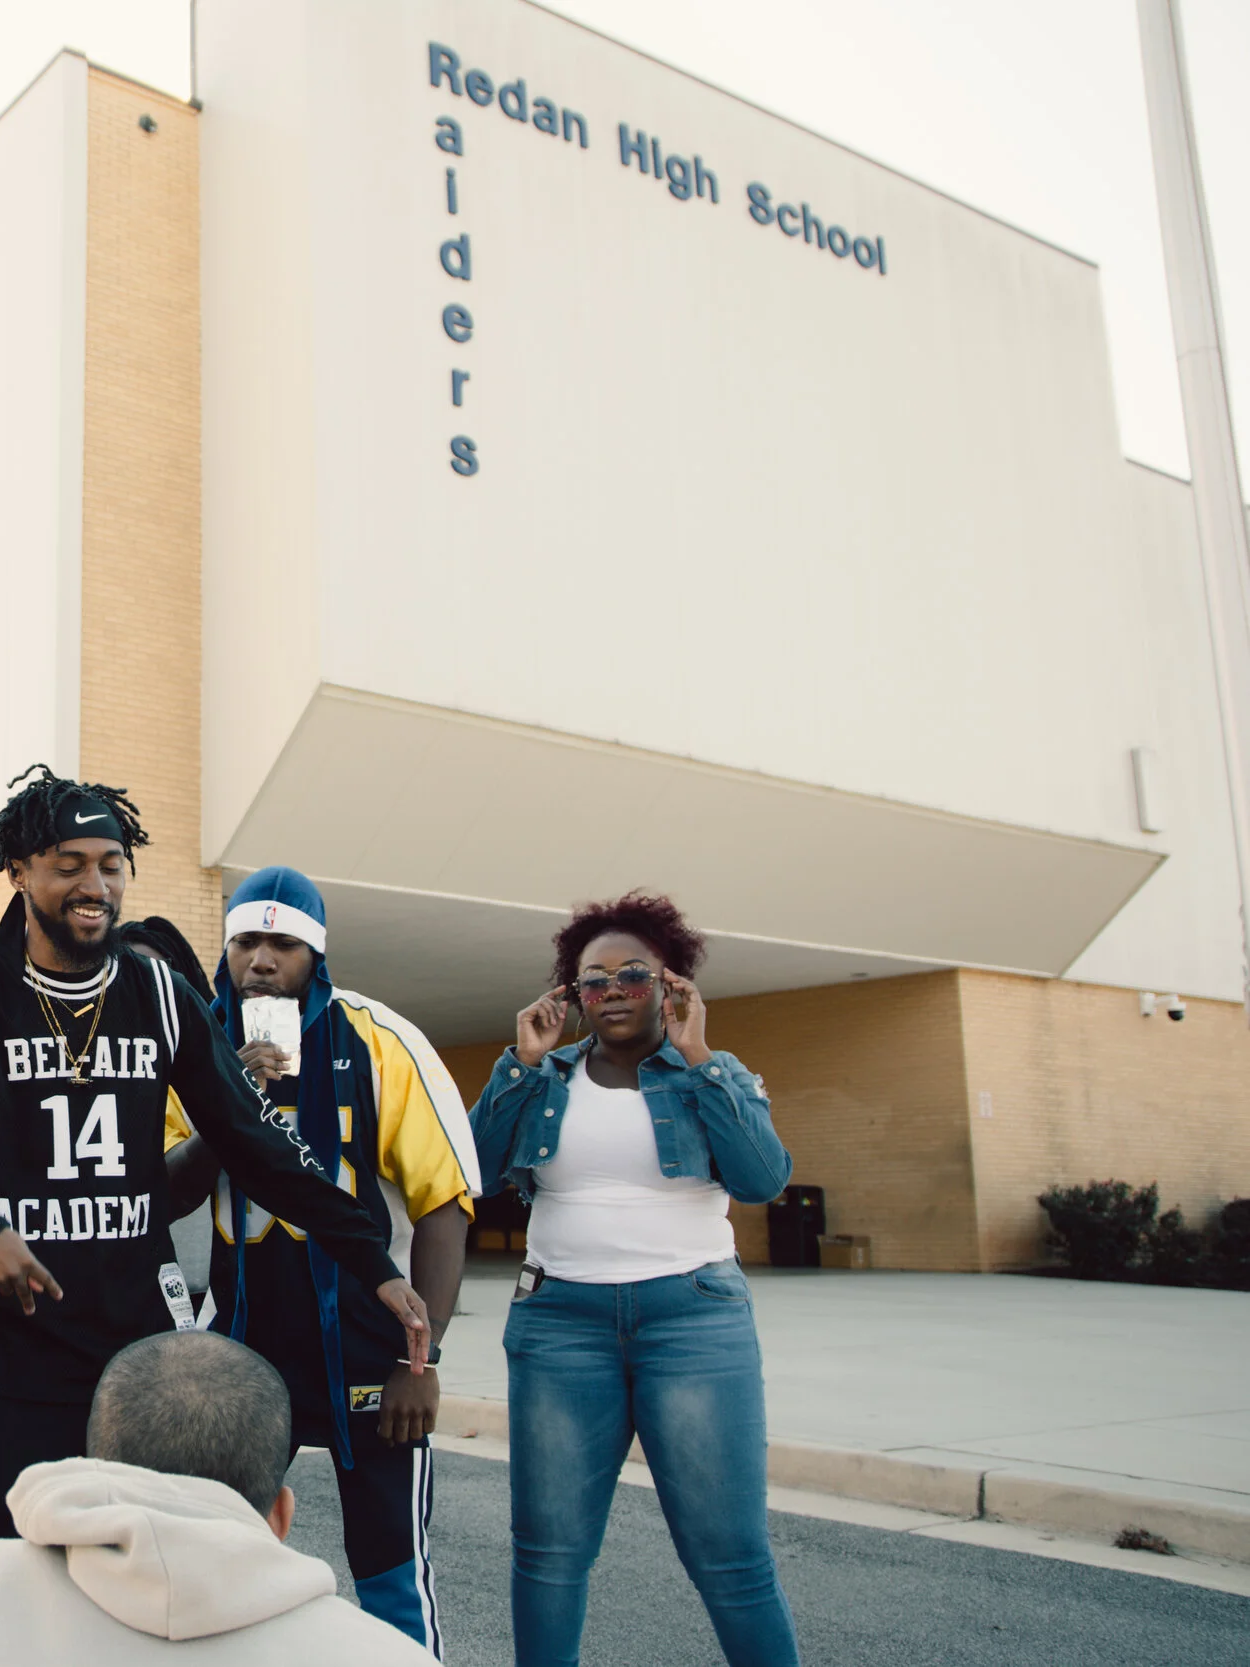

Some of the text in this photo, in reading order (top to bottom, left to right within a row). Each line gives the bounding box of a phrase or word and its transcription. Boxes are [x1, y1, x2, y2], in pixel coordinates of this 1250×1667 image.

[428, 42, 887, 275] Redan High School
[4, 1036, 158, 1081] BEL-AIR
[40, 1094, 126, 1179] 14
